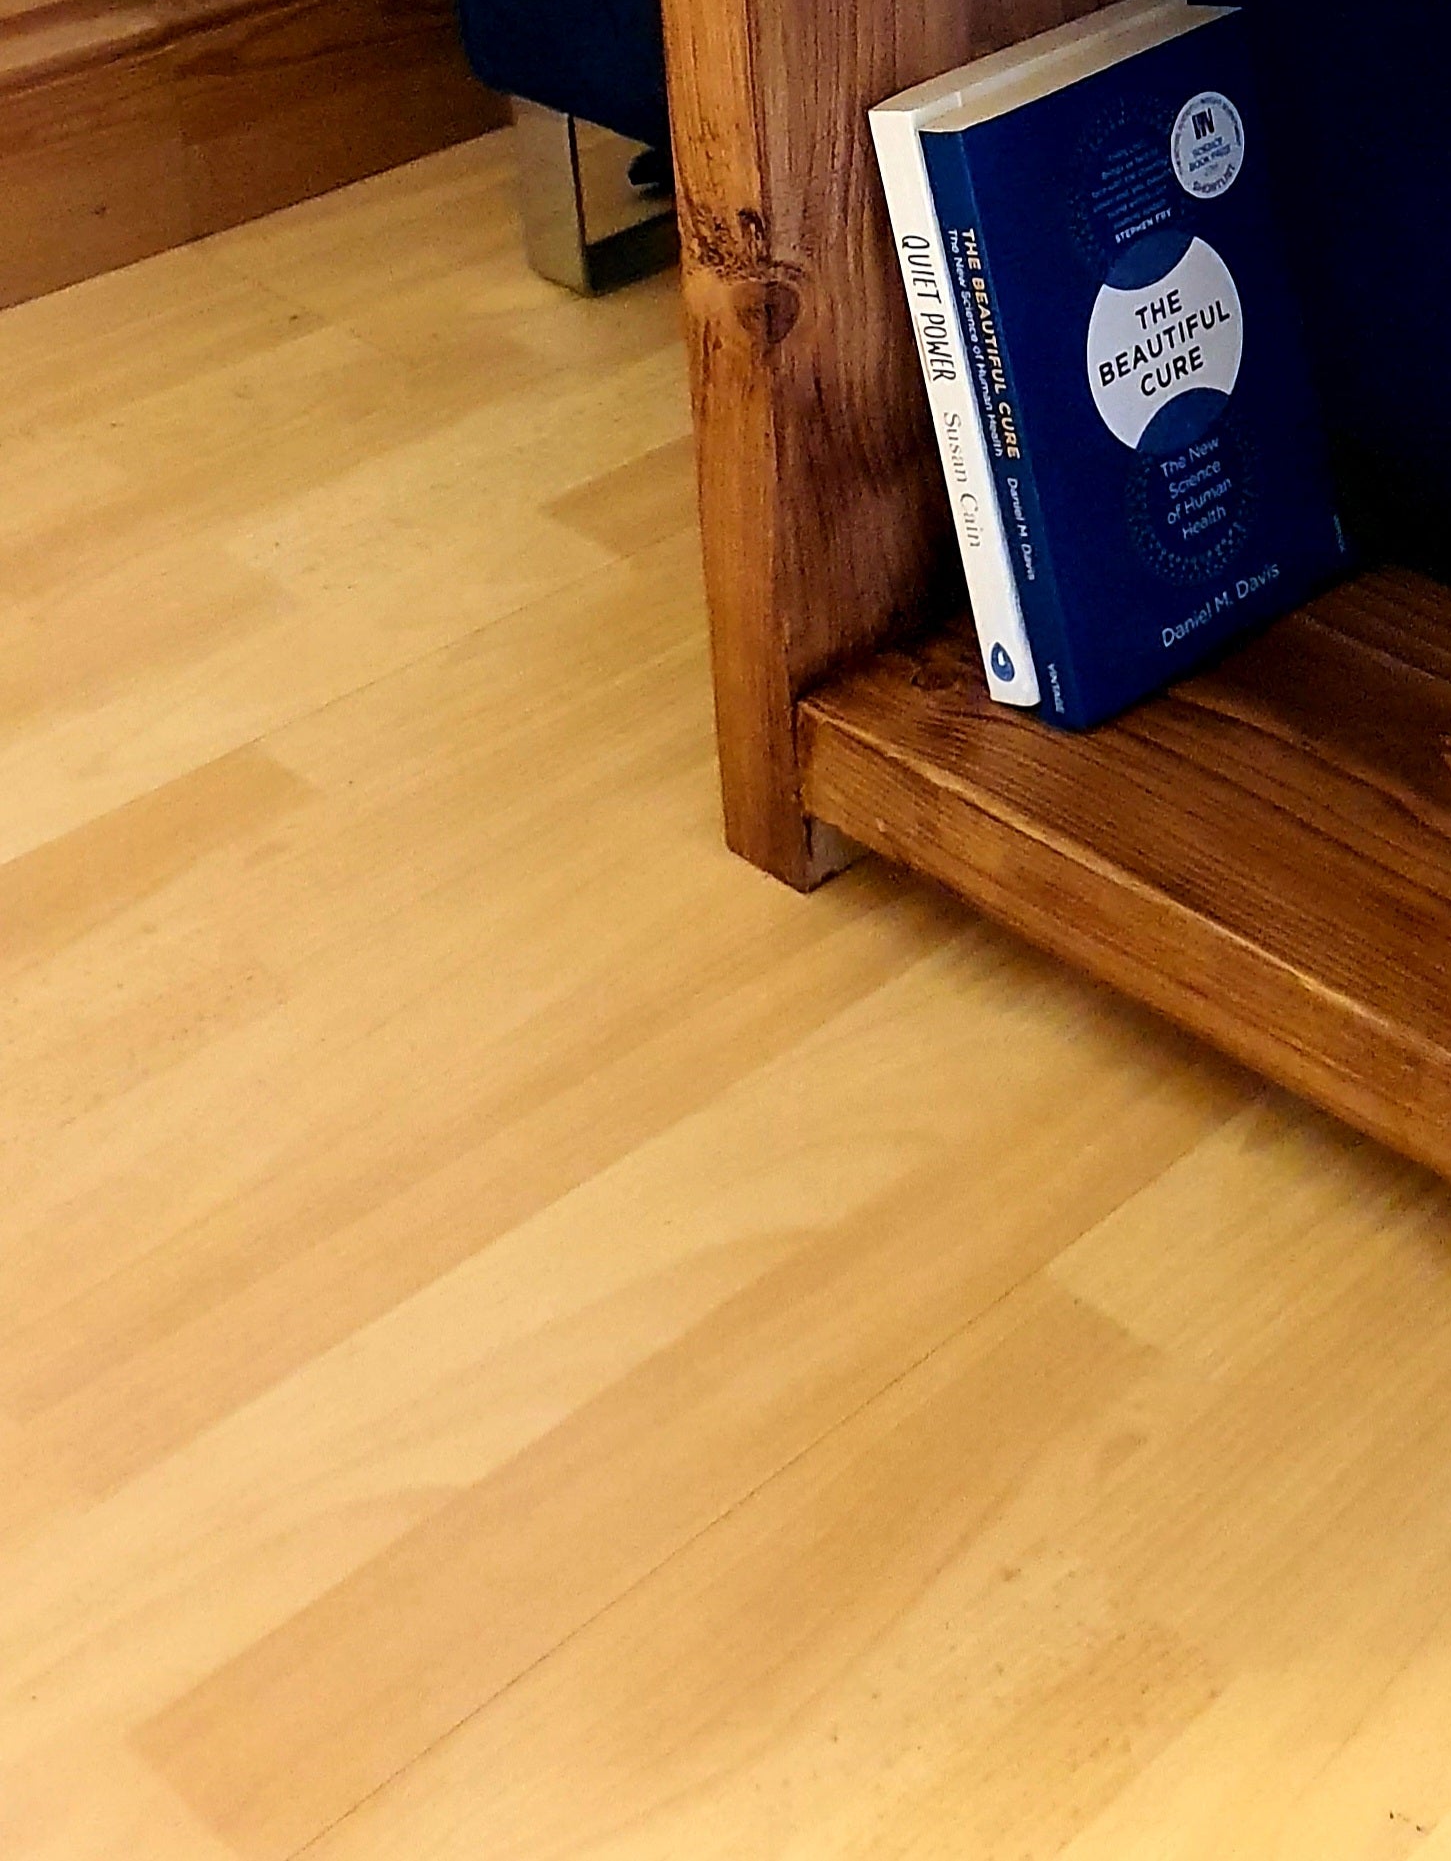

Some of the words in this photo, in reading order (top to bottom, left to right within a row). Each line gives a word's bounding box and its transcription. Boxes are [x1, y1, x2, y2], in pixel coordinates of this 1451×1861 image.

[947, 229, 961, 254] The
[961, 228, 982, 271] THE
[1114, 217, 1154, 244] STEPHEN
[1155, 207, 1172, 224] FRY
[902, 235, 942, 305] QUIET
[953, 256, 968, 289] New
[960, 290, 979, 344] Science
[1134, 288, 1183, 330] THE
[920, 312, 957, 382] POWER
[971, 277, 1007, 395] BEAUTIFUL
[972, 345, 985, 361] of
[1098, 299, 1231, 387] BEAUTIFUL
[976, 362, 994, 411] Human
[1140, 345, 1204, 397] CURE
[987, 413, 1004, 458] Health
[998, 401, 1021, 460] CURE
[943, 411, 969, 483] Susan
[959, 492, 984, 548] Cain
[1160, 455, 1187, 478] The
[1188, 437, 1220, 463] New
[1168, 460, 1222, 499] Science
[1166, 503, 1183, 525] of
[1184, 477, 1233, 515] Human
[1181, 505, 1227, 540] Health
[1006, 477, 1025, 521] Daniel
[1020, 543, 1036, 581] Davis
[1161, 601, 1213, 648] Daniel
[1214, 591, 1234, 613] M.
[1235, 563, 1281, 600] Davis
